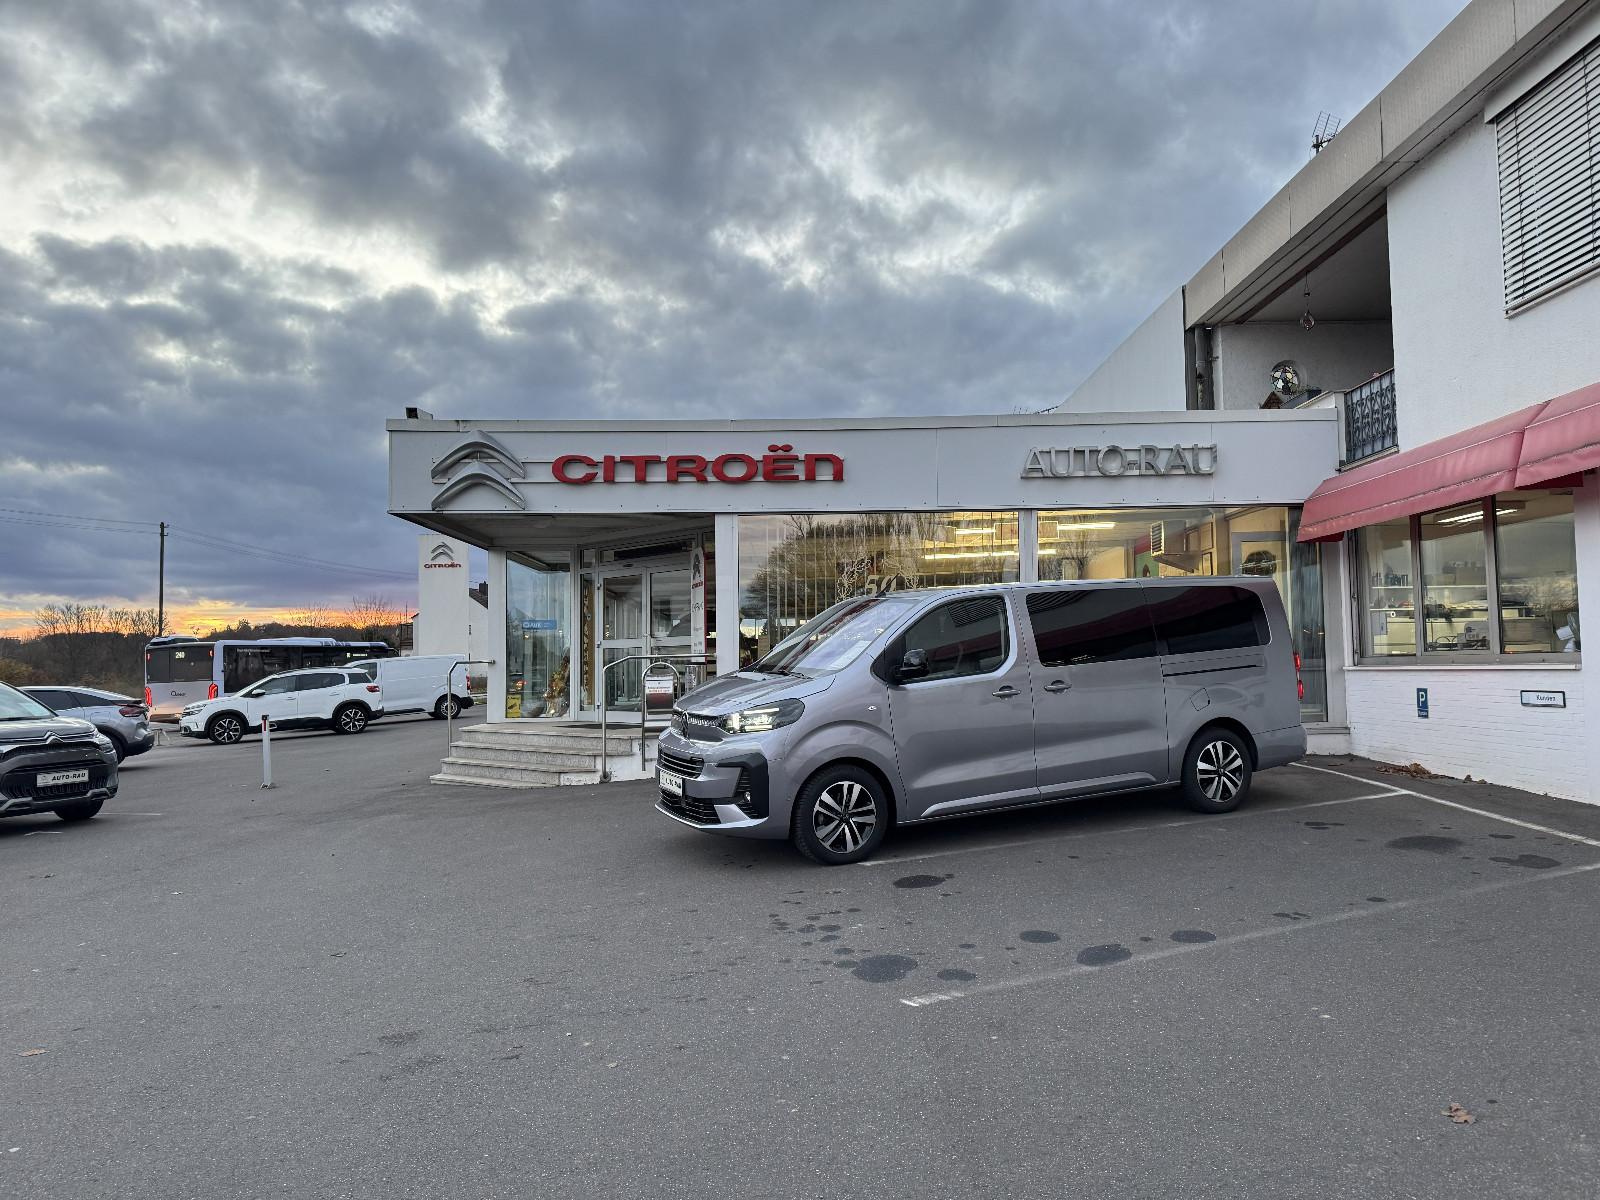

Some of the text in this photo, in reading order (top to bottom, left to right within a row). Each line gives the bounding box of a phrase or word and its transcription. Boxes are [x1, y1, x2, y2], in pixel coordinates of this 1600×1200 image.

[1021, 444, 1218, 479] AUTO-RAU
[1419, 691, 1426, 706] P
[52, 772, 86, 782] AUTO-RAU
